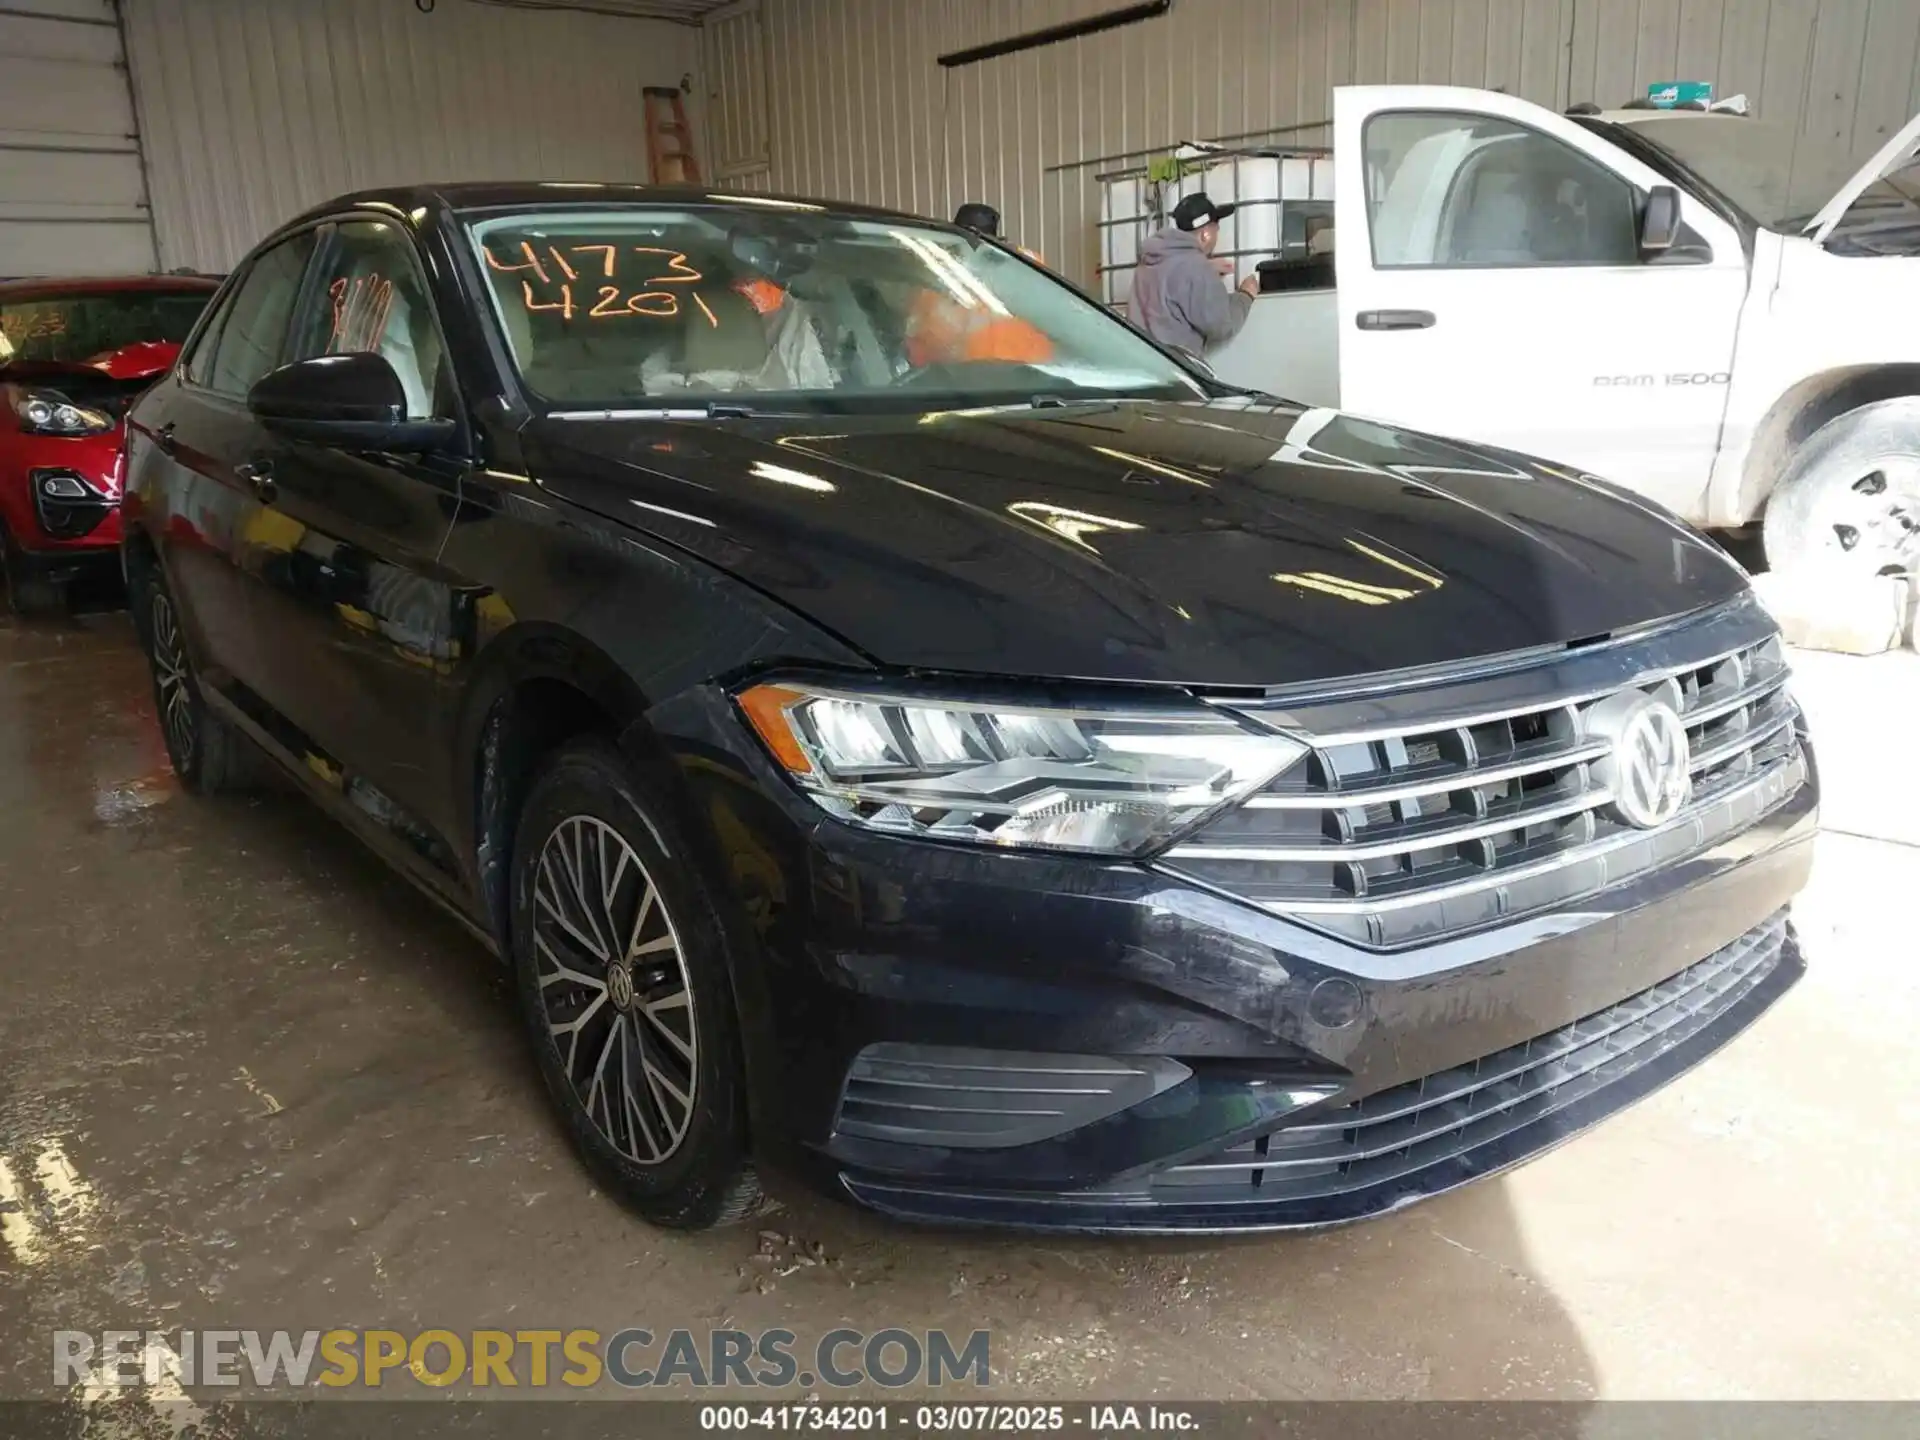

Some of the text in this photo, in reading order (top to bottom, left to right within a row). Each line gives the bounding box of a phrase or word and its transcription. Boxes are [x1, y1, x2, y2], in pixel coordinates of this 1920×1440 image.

[482, 241, 702, 284] 4173
[522, 282, 717, 328] 4201
[1665, 372, 1731, 385] 1500
